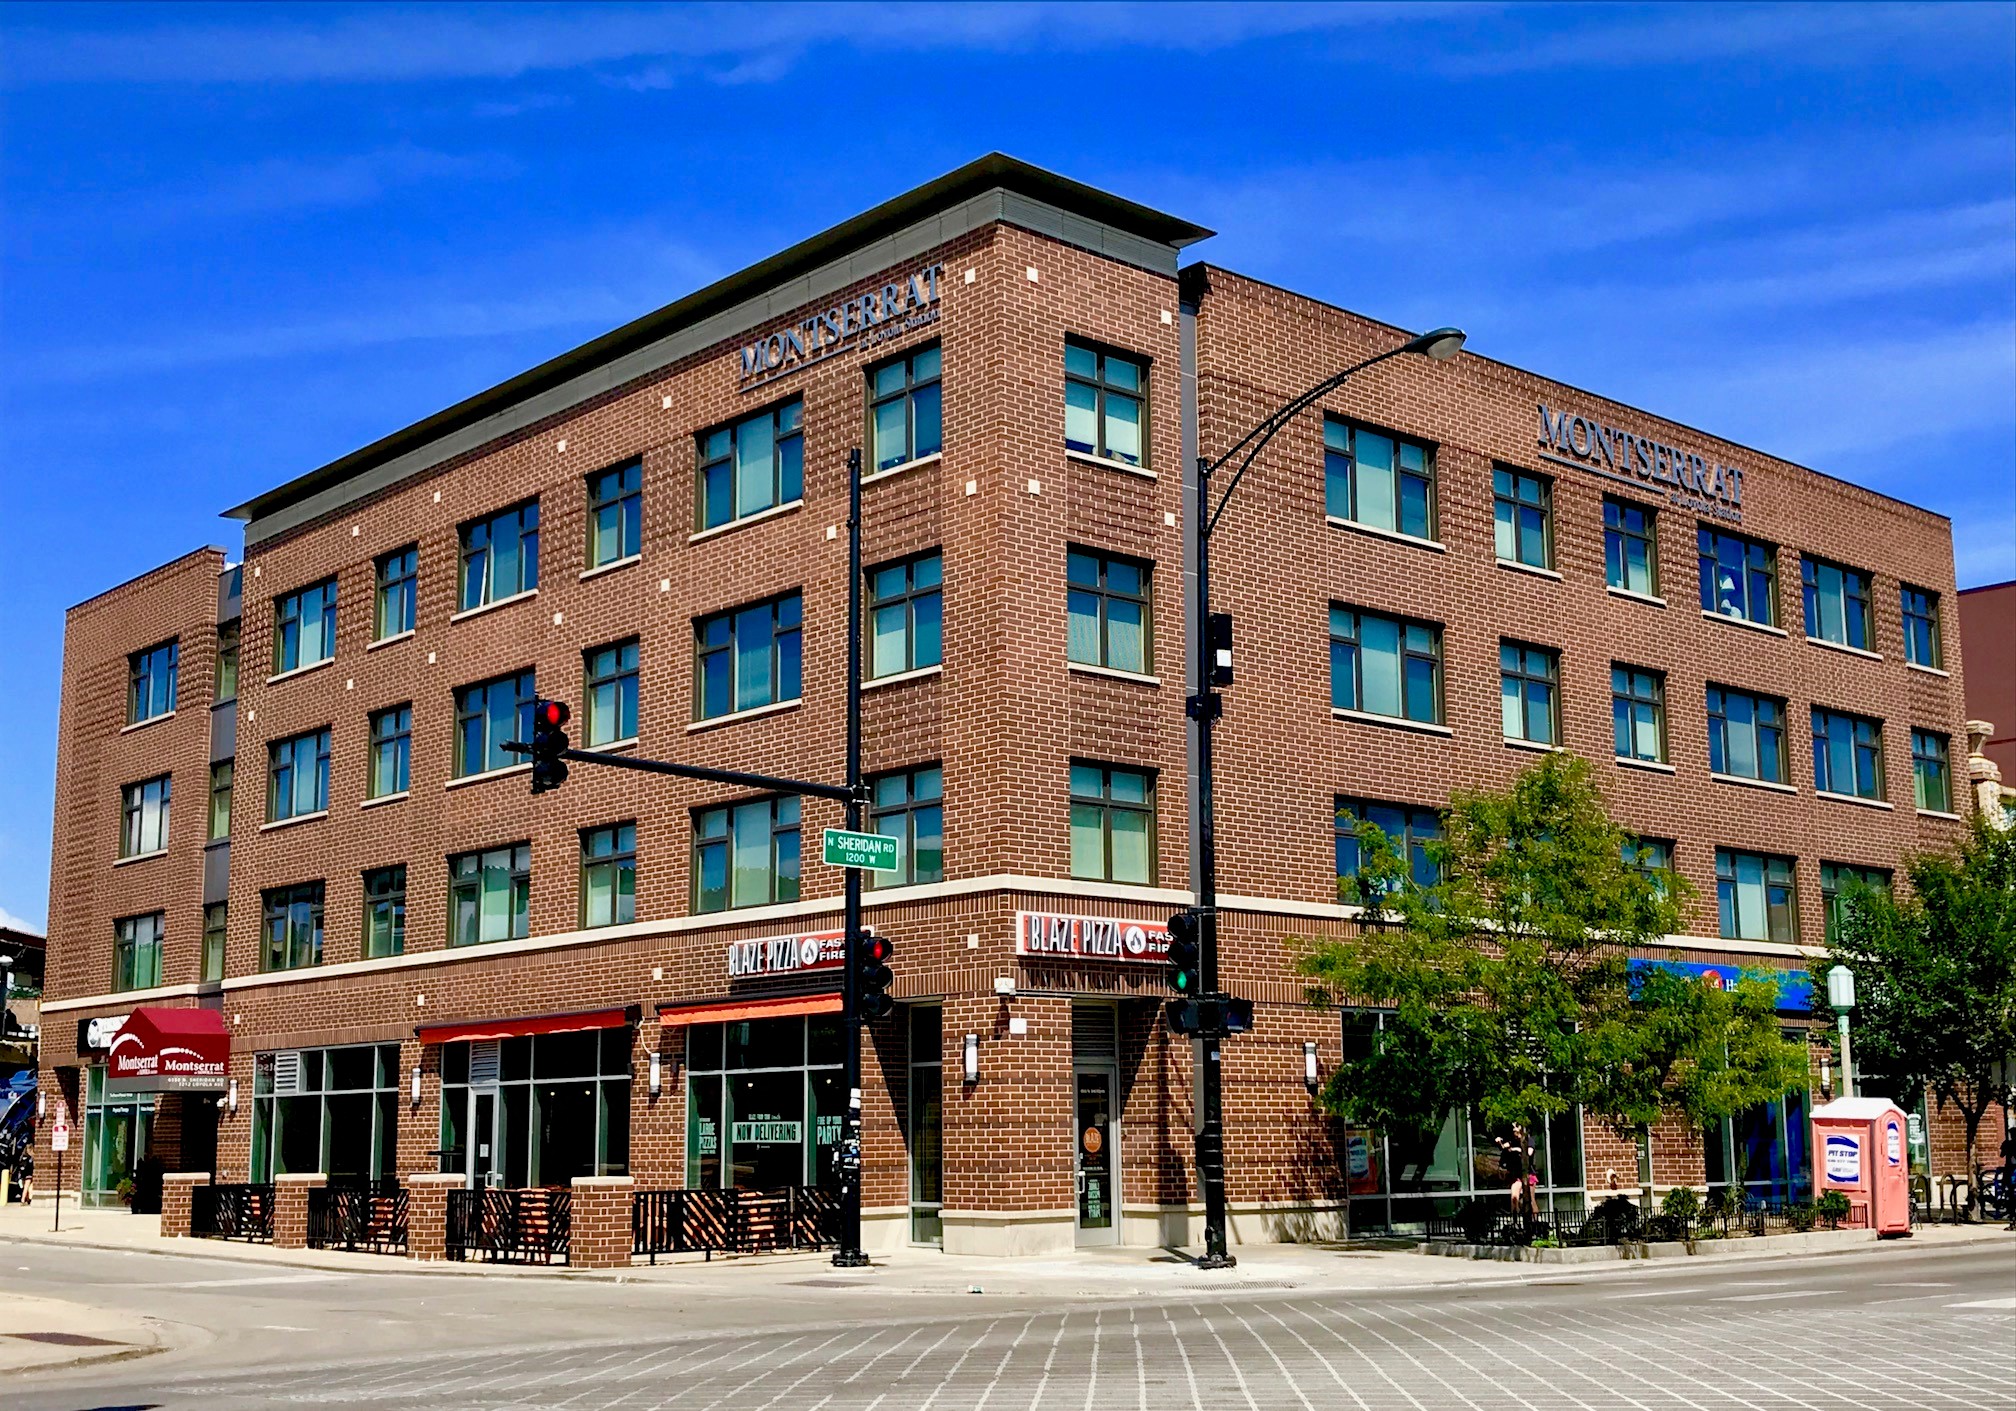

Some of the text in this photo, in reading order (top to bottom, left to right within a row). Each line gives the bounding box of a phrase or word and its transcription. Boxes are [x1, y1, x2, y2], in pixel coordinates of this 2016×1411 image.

[739, 262, 943, 380] MONTSERRAT
[1537, 405, 1743, 505] MONTSERRAT
[827, 835, 894, 853] N SHERIDAN RD
[846, 852, 876, 864] 1200 W
[1031, 915, 1122, 955] BLAZE PIZZA
[1148, 930, 1174, 941] FAS
[729, 938, 799, 975] BLAZE PIZZA
[118, 1054, 158, 1071] Montserrat
[165, 1060, 224, 1071] Montserrat
[737, 1124, 796, 1141] NOW DELIVERING
[817, 1125, 842, 1145] PARTY
